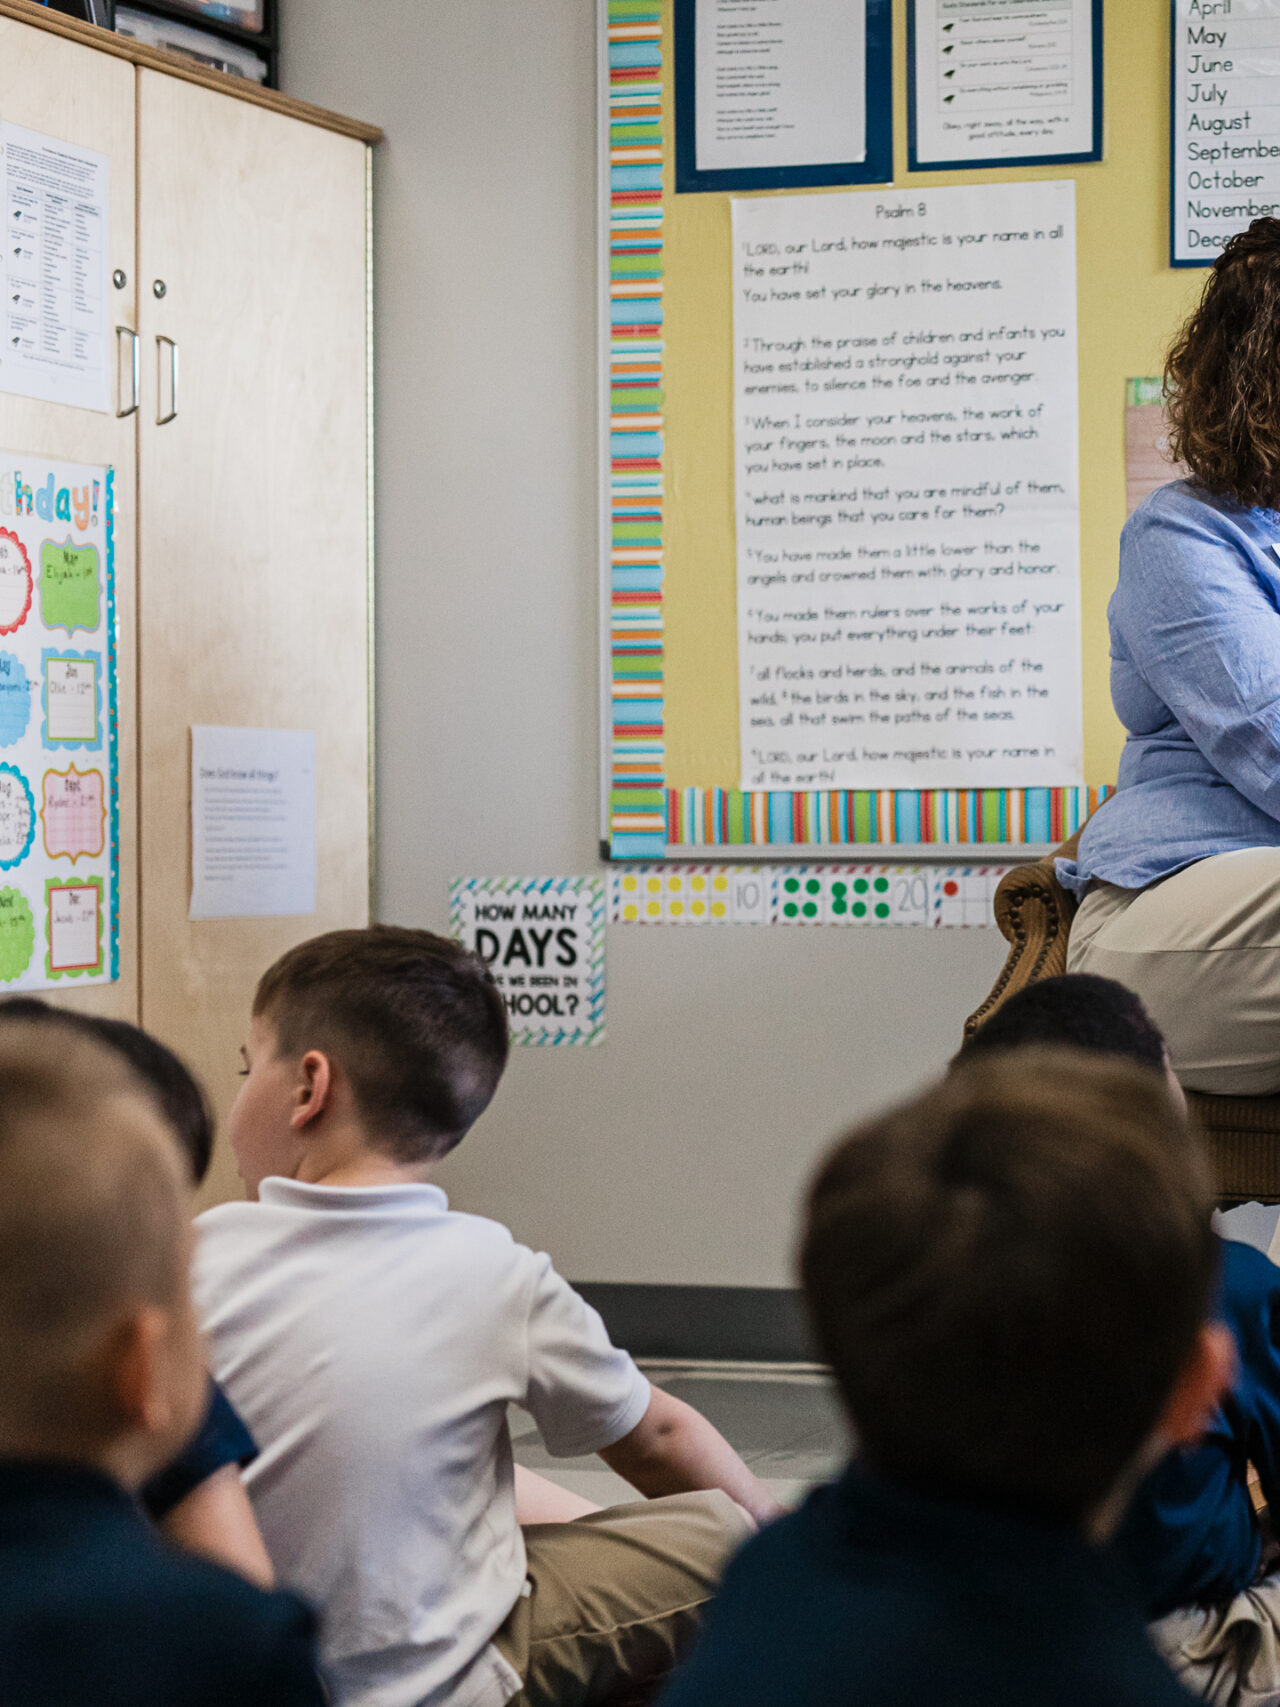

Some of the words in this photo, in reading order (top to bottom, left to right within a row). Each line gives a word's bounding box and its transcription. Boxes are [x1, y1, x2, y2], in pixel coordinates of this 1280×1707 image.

[1189, 0, 1231, 20] April
[1188, 26, 1227, 48] May
[1187, 55, 1233, 74] June
[1187, 83, 1228, 106] July
[1187, 111, 1252, 135] August
[1188, 169, 1264, 189] October
[1187, 198, 1280, 218] November
[1188, 229, 1232, 248] Dece
[0, 471, 100, 531] thday!
[736, 881, 760, 910] 10
[897, 877, 927, 912] 20
[475, 905, 516, 921] HOW
[522, 905, 577, 920] MANY
[475, 928, 577, 967] DAYS
[509, 976, 525, 987] WE
[530, 976, 559, 987] BEEN
[563, 976, 577, 987] IN
[503, 993, 580, 1016] HOOL?
